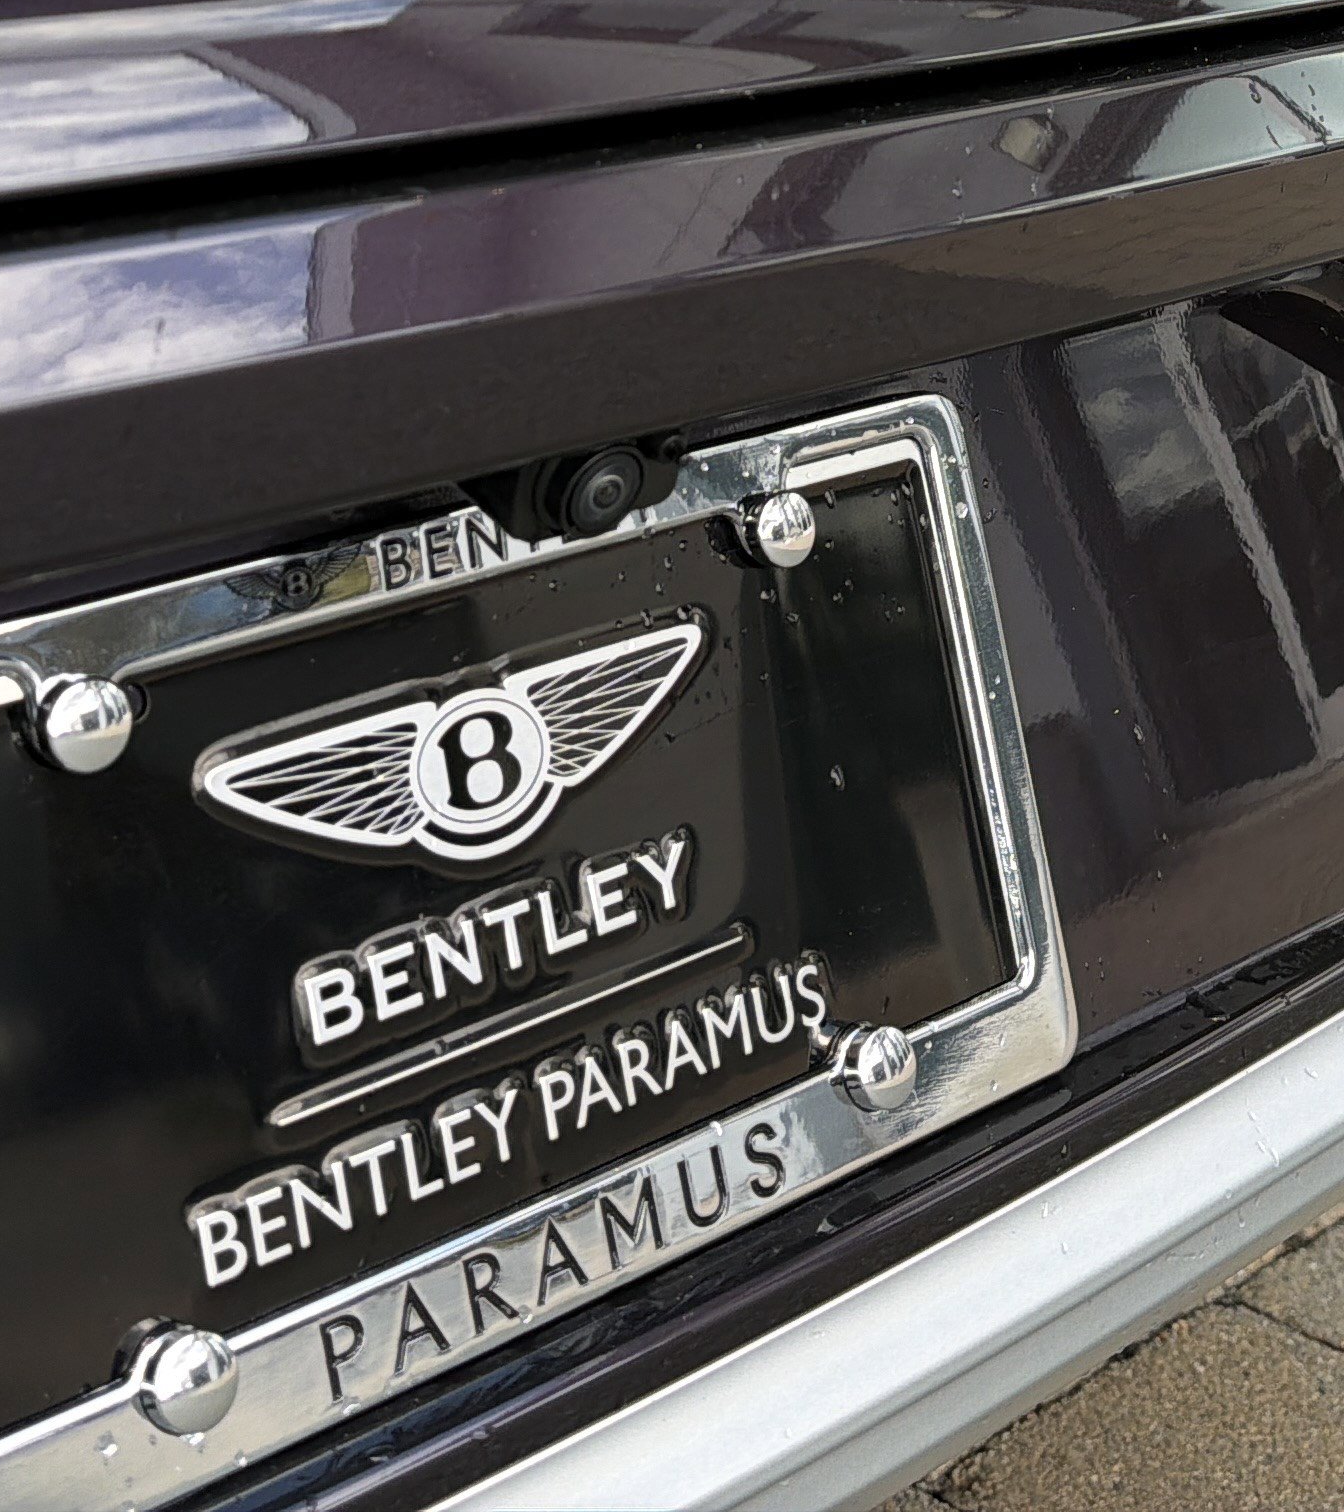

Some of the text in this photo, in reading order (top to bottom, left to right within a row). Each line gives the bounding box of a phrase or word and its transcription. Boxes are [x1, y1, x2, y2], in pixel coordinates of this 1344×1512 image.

[437, 710, 526, 811] B
[303, 840, 687, 1046] BENTLEY
[195, 963, 827, 1287] BENTLEY PARAMUS
[318, 1123, 788, 1404] PARAMUS
